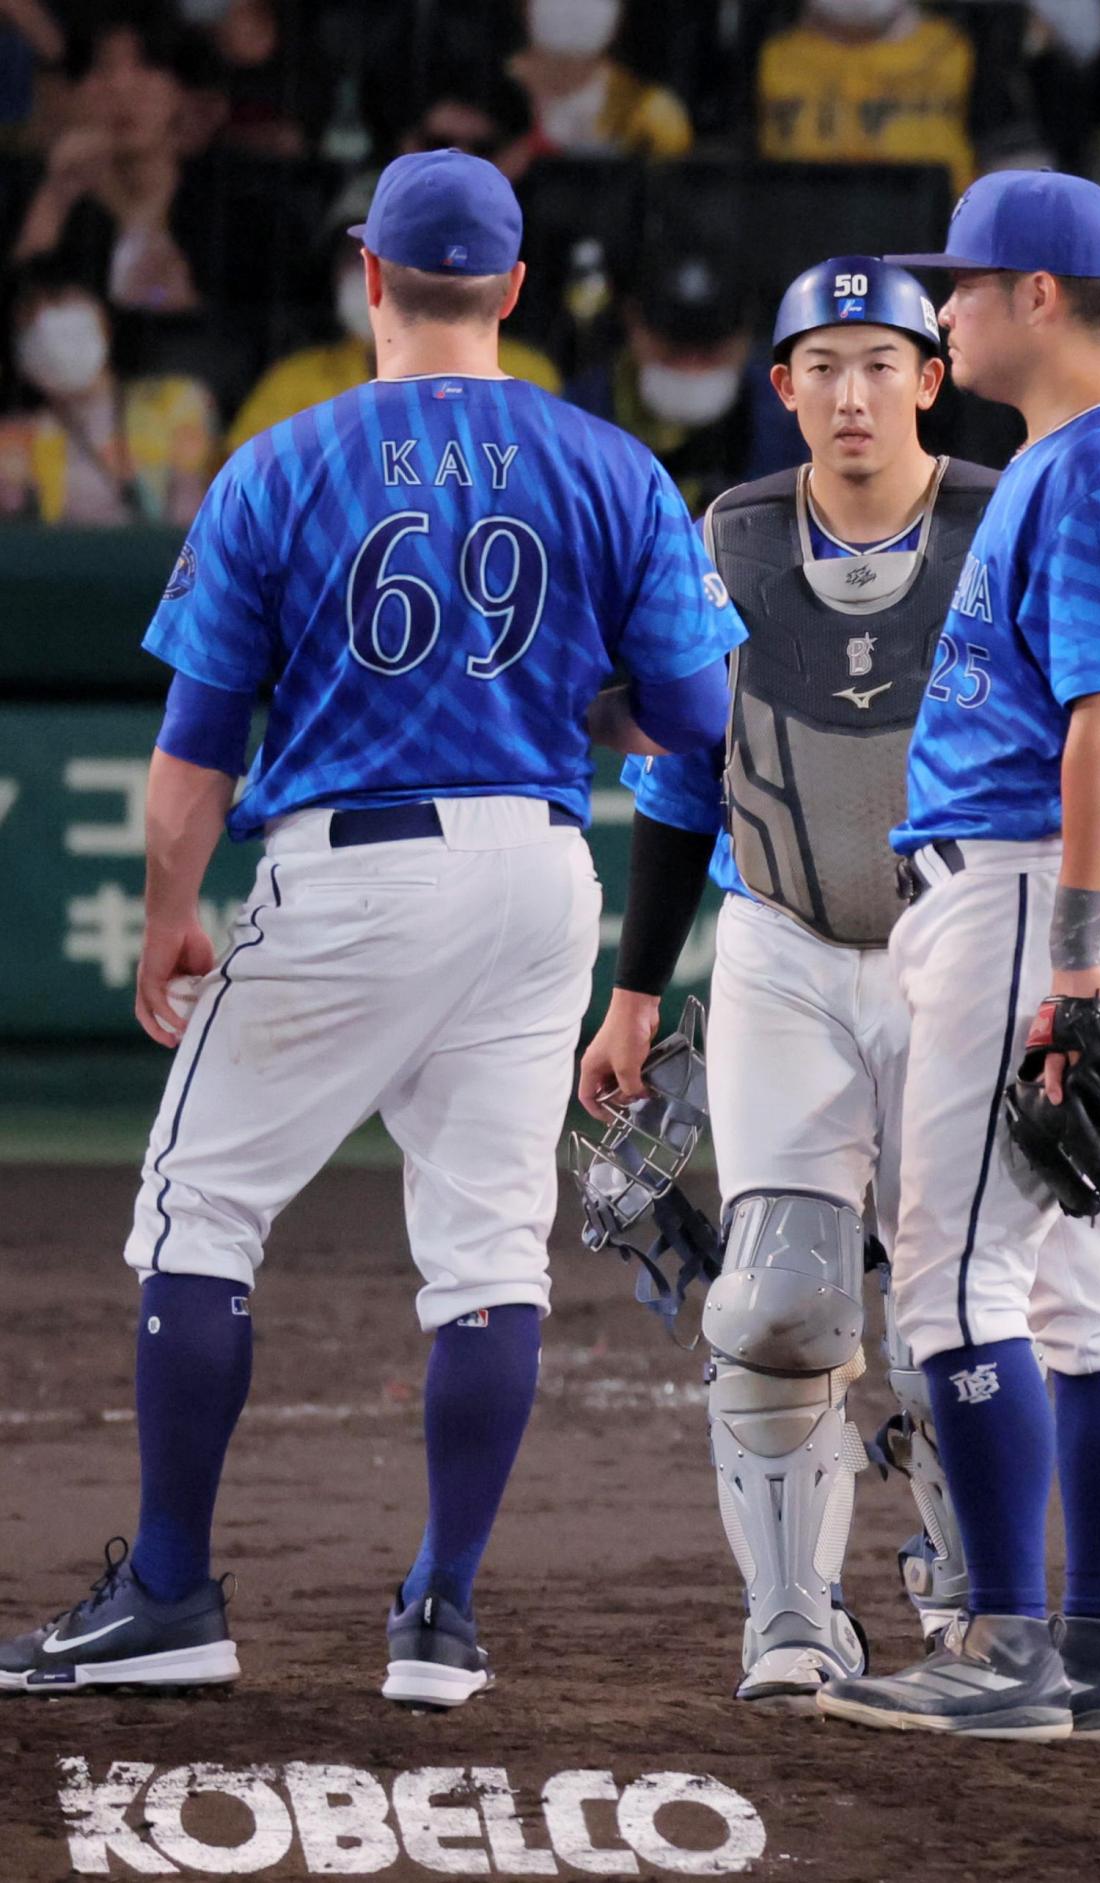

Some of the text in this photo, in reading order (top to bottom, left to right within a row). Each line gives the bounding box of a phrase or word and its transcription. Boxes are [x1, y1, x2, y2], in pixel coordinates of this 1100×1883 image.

[833, 273, 869, 298] 50
[381, 439, 519, 490] KAY
[346, 511, 548, 680] 69
[926, 632, 992, 709] 25
[57, 1758, 768, 1876] KOBELCO
